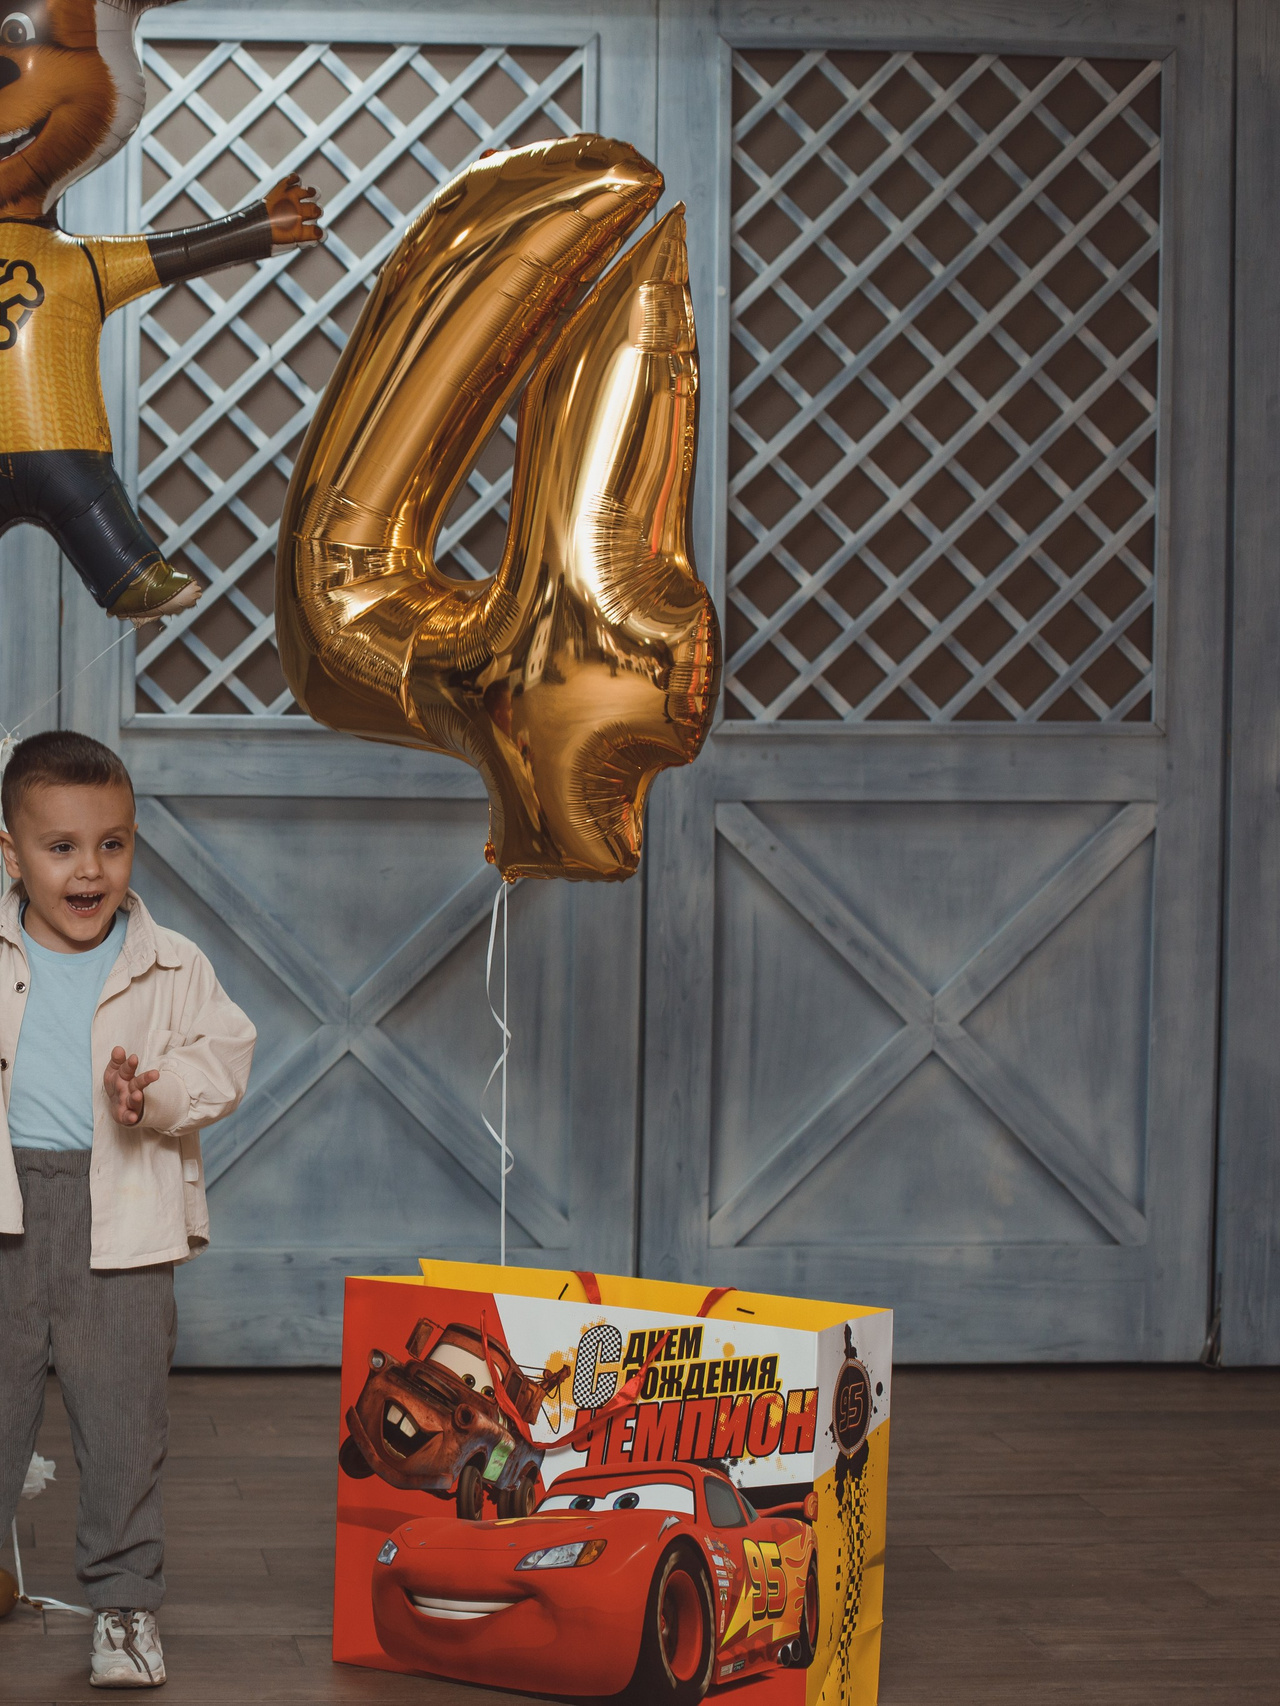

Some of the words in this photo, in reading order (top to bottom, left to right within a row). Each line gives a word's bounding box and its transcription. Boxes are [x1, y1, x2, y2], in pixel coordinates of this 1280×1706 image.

[571, 1388, 819, 1467] ЧЕМПИОН
[839, 1381, 864, 1433] 95
[742, 1538, 788, 1622] 95
